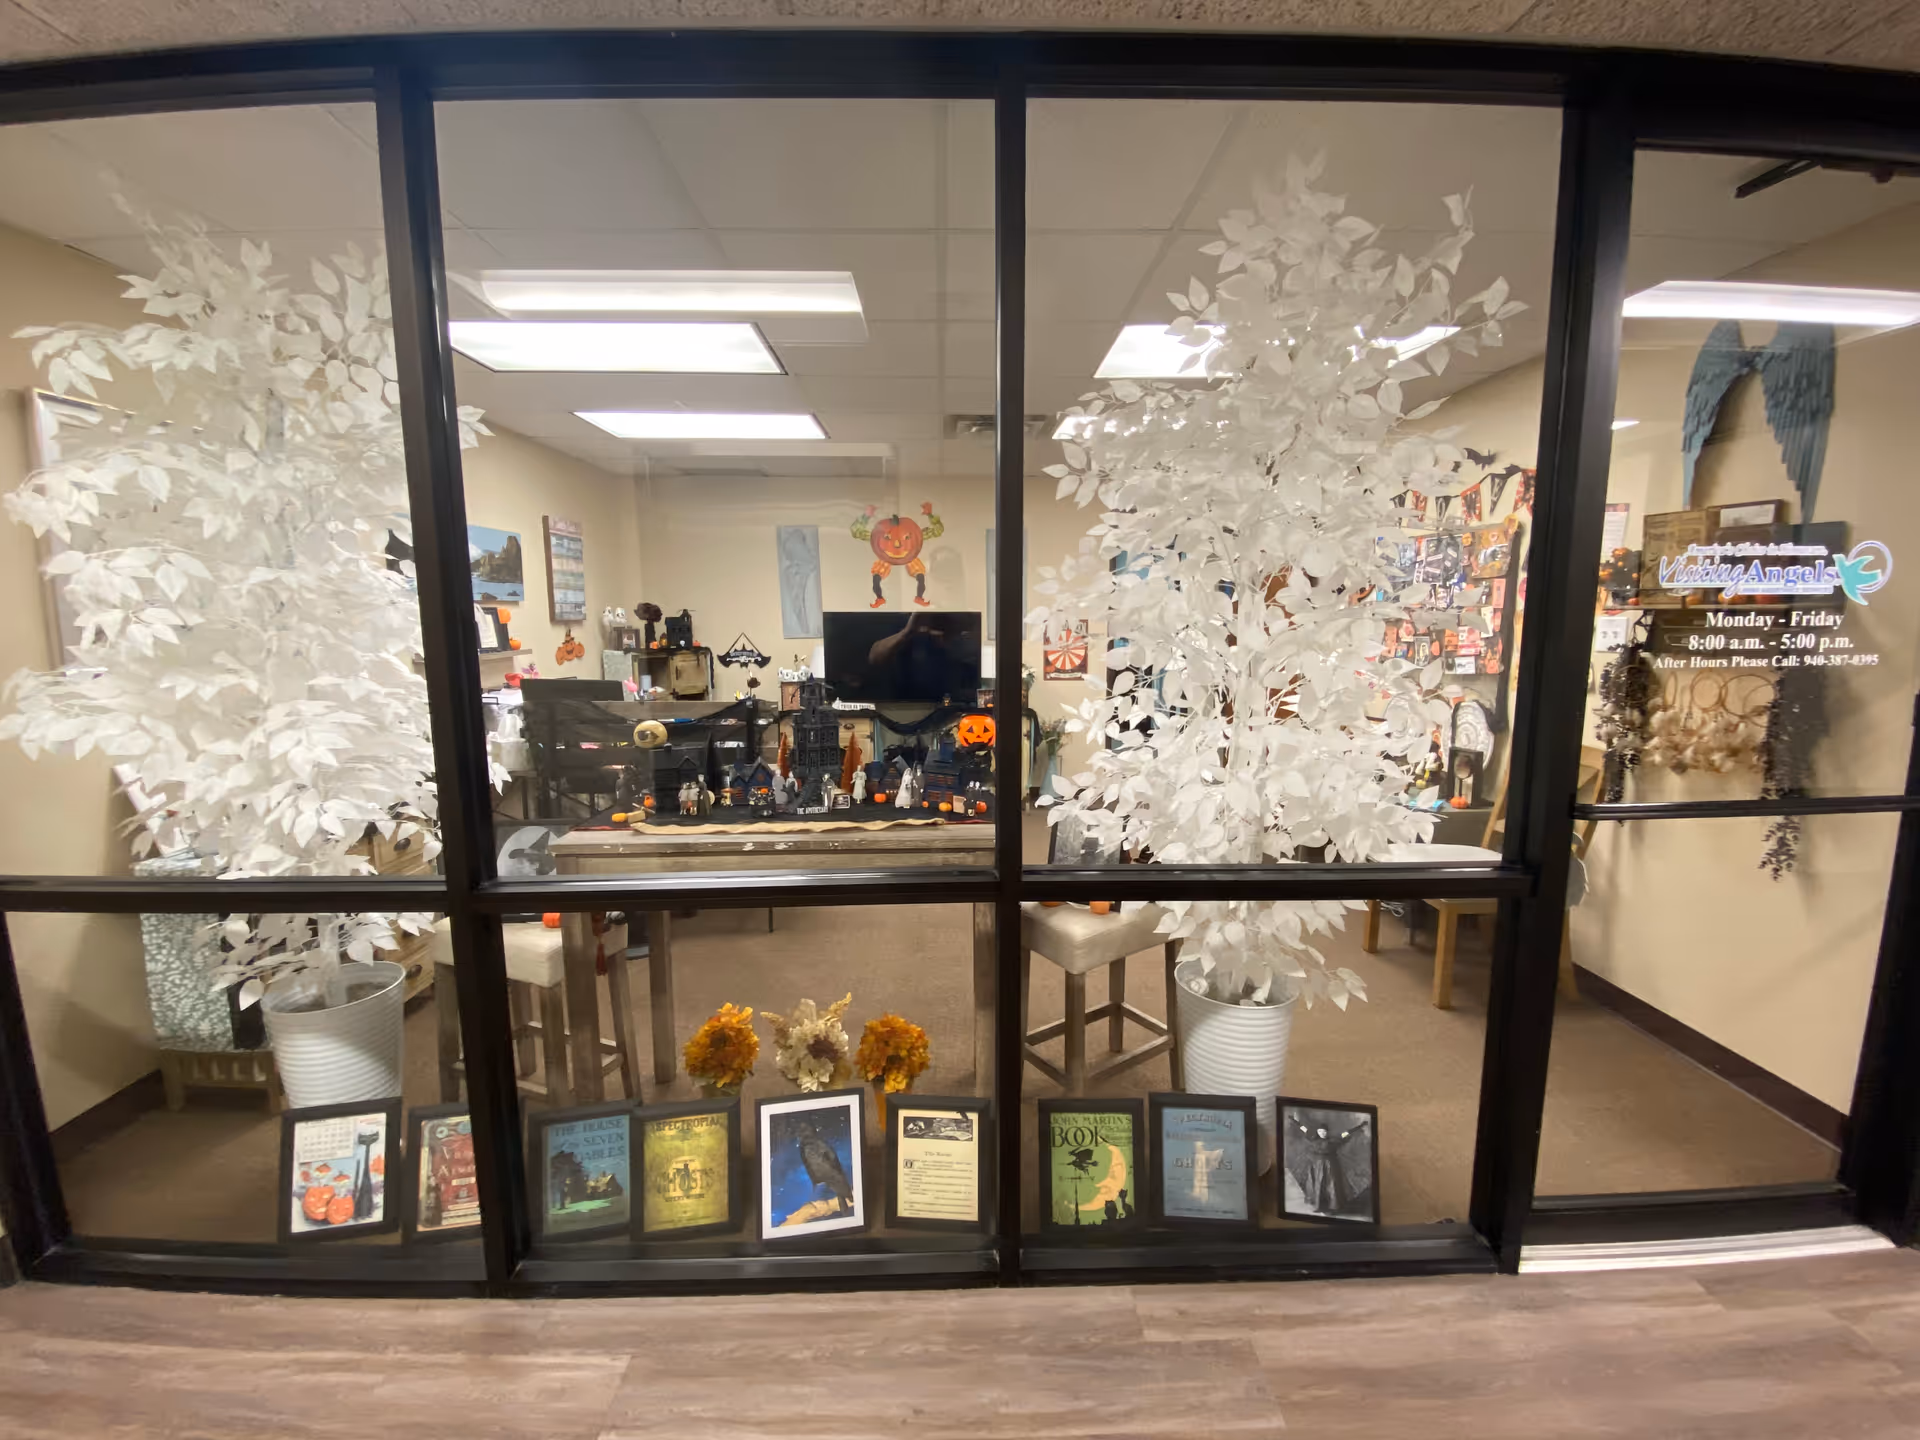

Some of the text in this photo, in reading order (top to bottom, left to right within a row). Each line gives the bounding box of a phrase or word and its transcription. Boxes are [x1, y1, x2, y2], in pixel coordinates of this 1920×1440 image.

[1660, 556, 1842, 597] Visiting Angels
[1705, 611, 1775, 631] Monday
[1790, 611, 1844, 630] Friday
[1688, 634, 1725, 650] 8:00
[1729, 638, 1765, 650] a.m.
[1780, 633, 1815, 649] 5:00
[1818, 636, 1854, 652] p.m.
[1653, 654, 1880, 669] After Hours Please Call: 940-387-0395
[1051, 1126, 1105, 1148] BOOK
